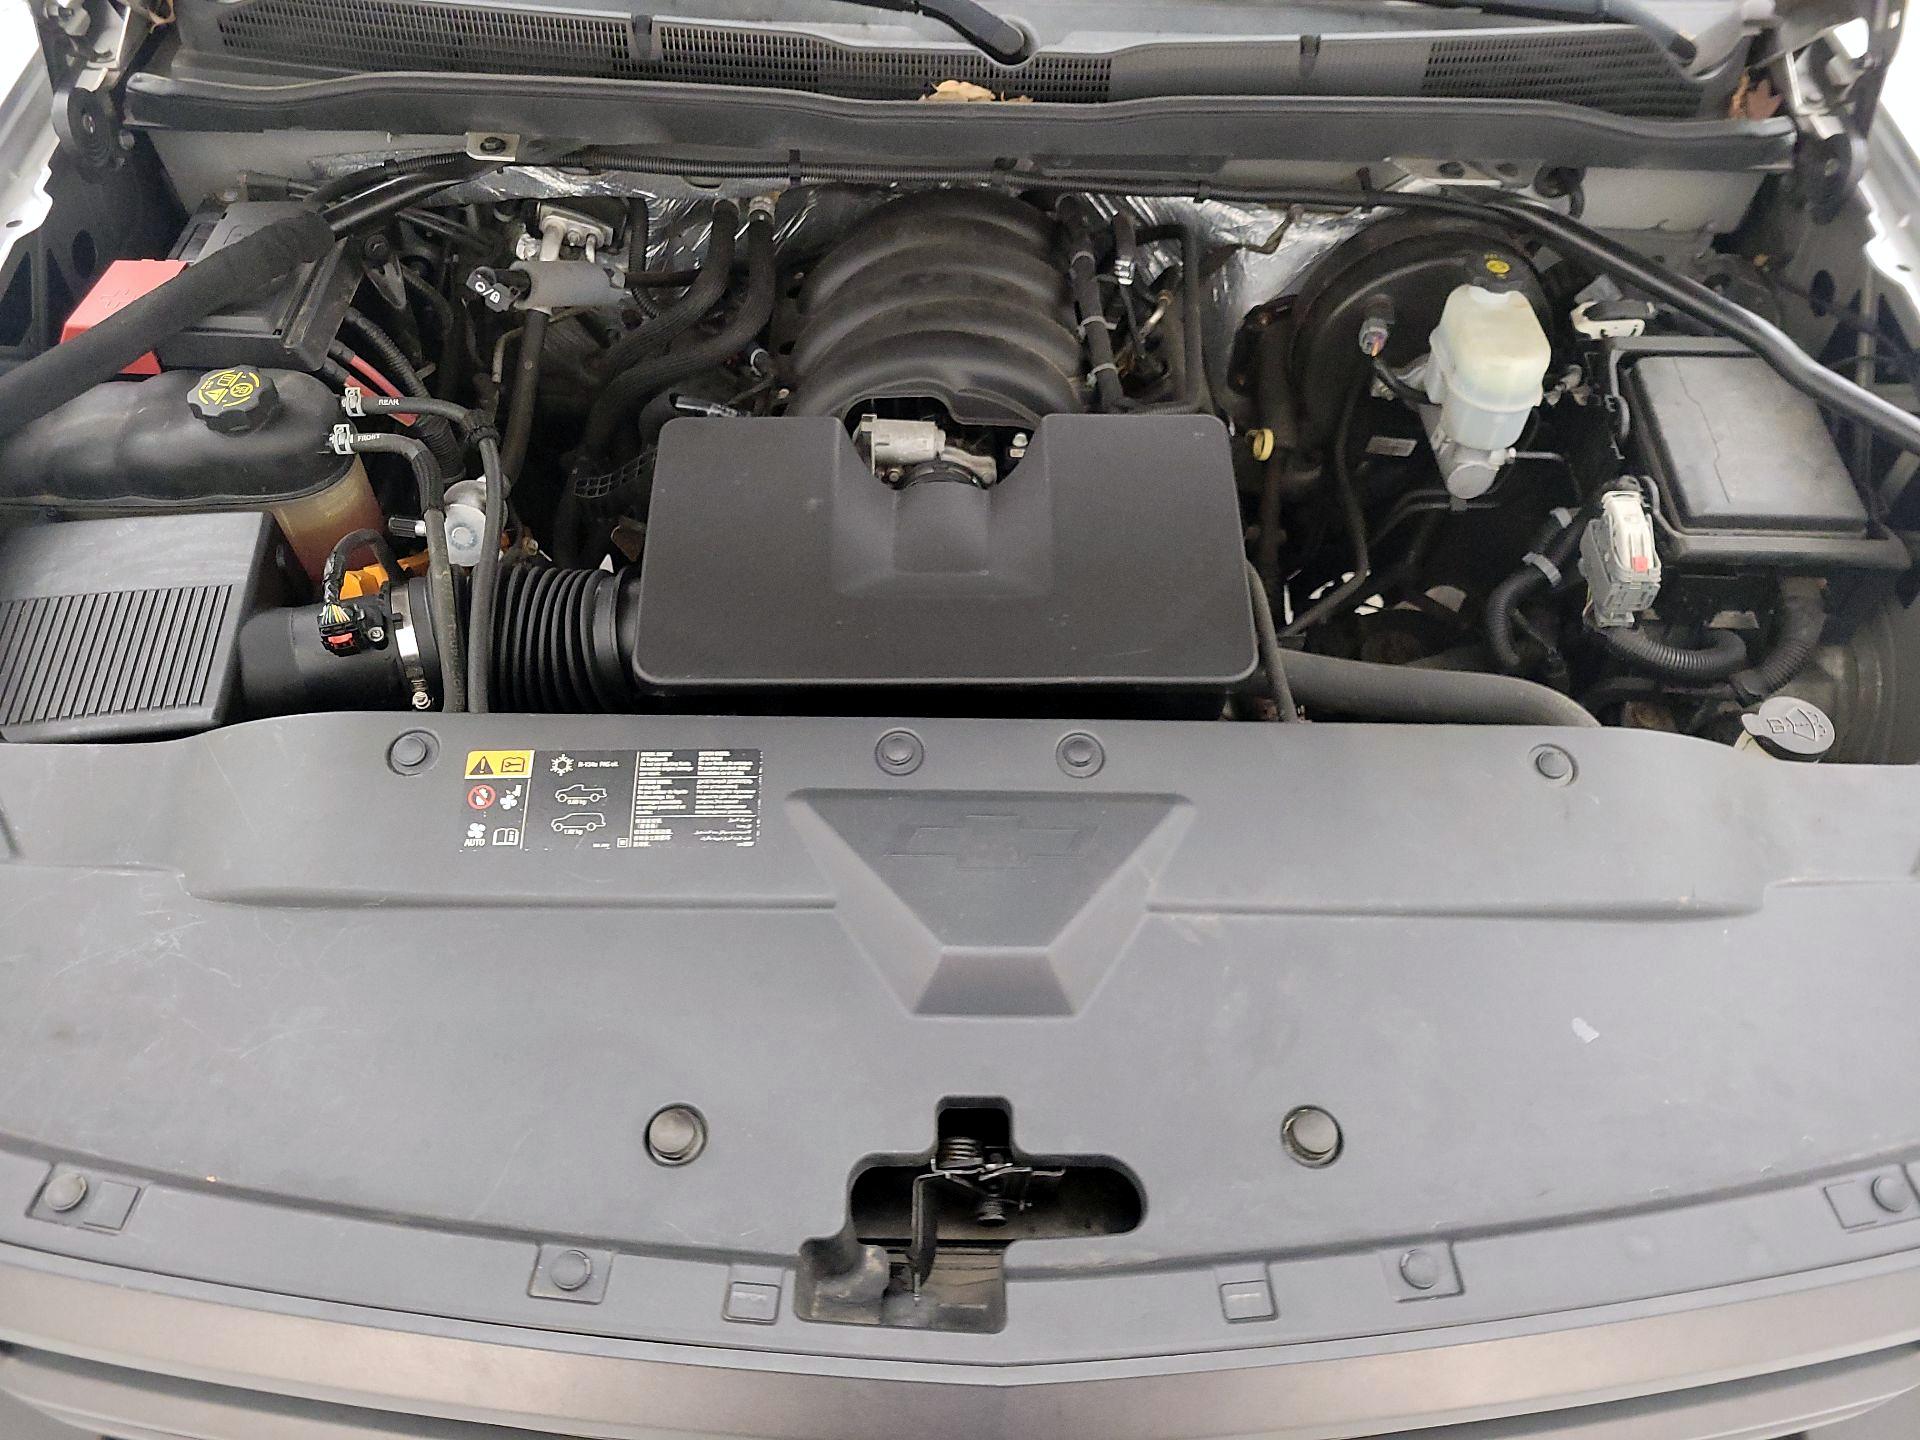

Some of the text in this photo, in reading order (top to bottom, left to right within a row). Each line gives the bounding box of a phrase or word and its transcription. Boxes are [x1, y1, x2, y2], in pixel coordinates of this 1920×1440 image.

[378, 398, 400, 406] REAR
[357, 433, 381, 442] FRONT
[463, 838, 486, 847] AUTO
